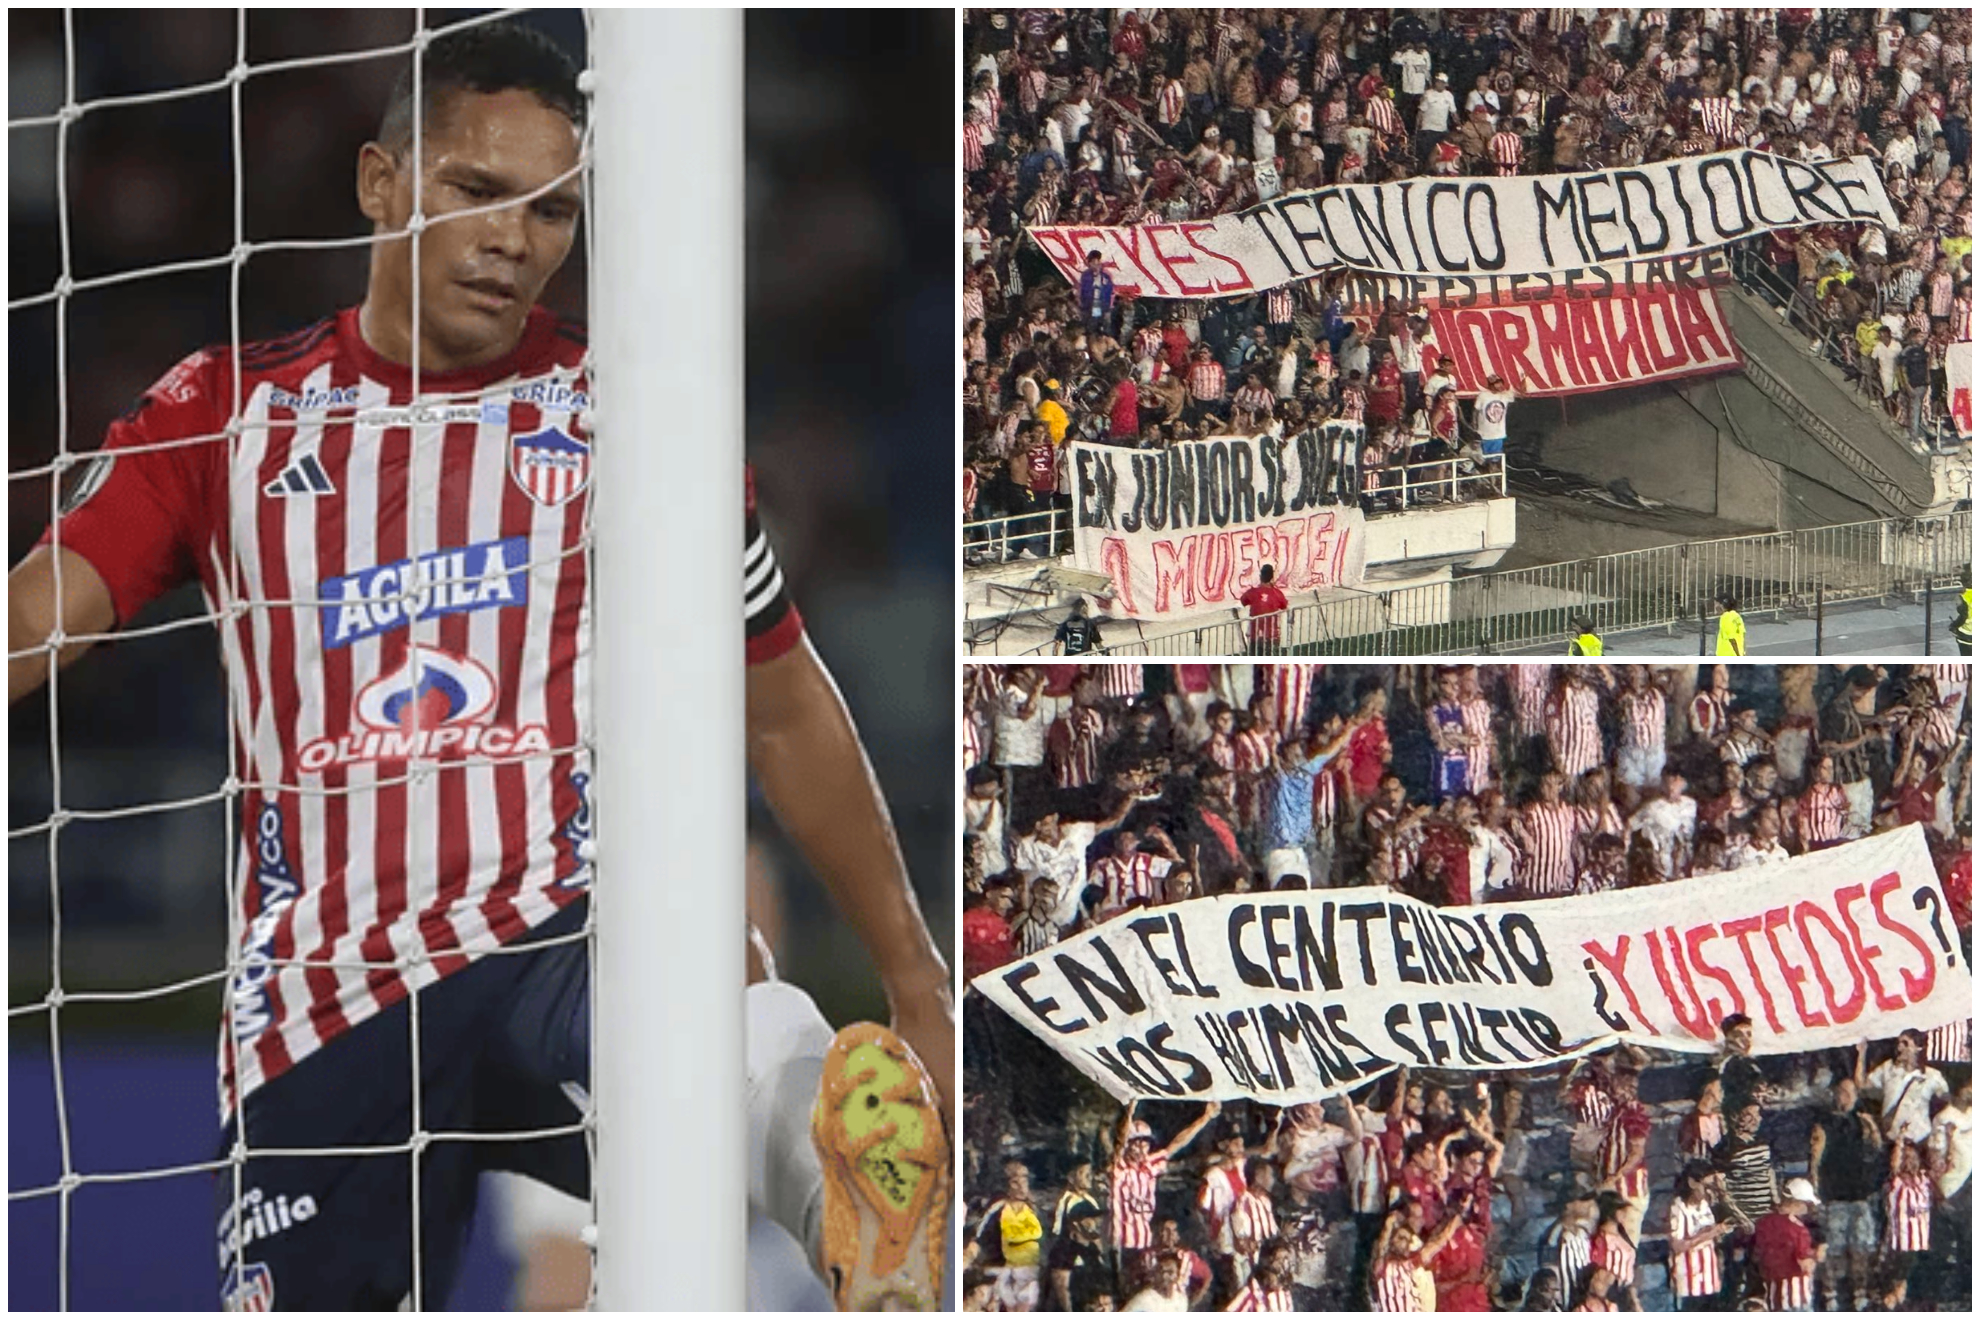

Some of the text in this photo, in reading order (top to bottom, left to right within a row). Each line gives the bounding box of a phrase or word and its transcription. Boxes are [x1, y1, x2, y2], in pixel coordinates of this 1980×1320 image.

[1033, 150, 1880, 296] REYES TECNICO MEDIOCRE
[1076, 447, 1117, 531] EN
[1121, 440, 1255, 533] JUNIOR
[335, 545, 514, 640] AGUILA
[300, 726, 551, 770] OLIMPICA
[1002, 935, 1147, 1034] EN
[1127, 912, 1221, 998] EL
